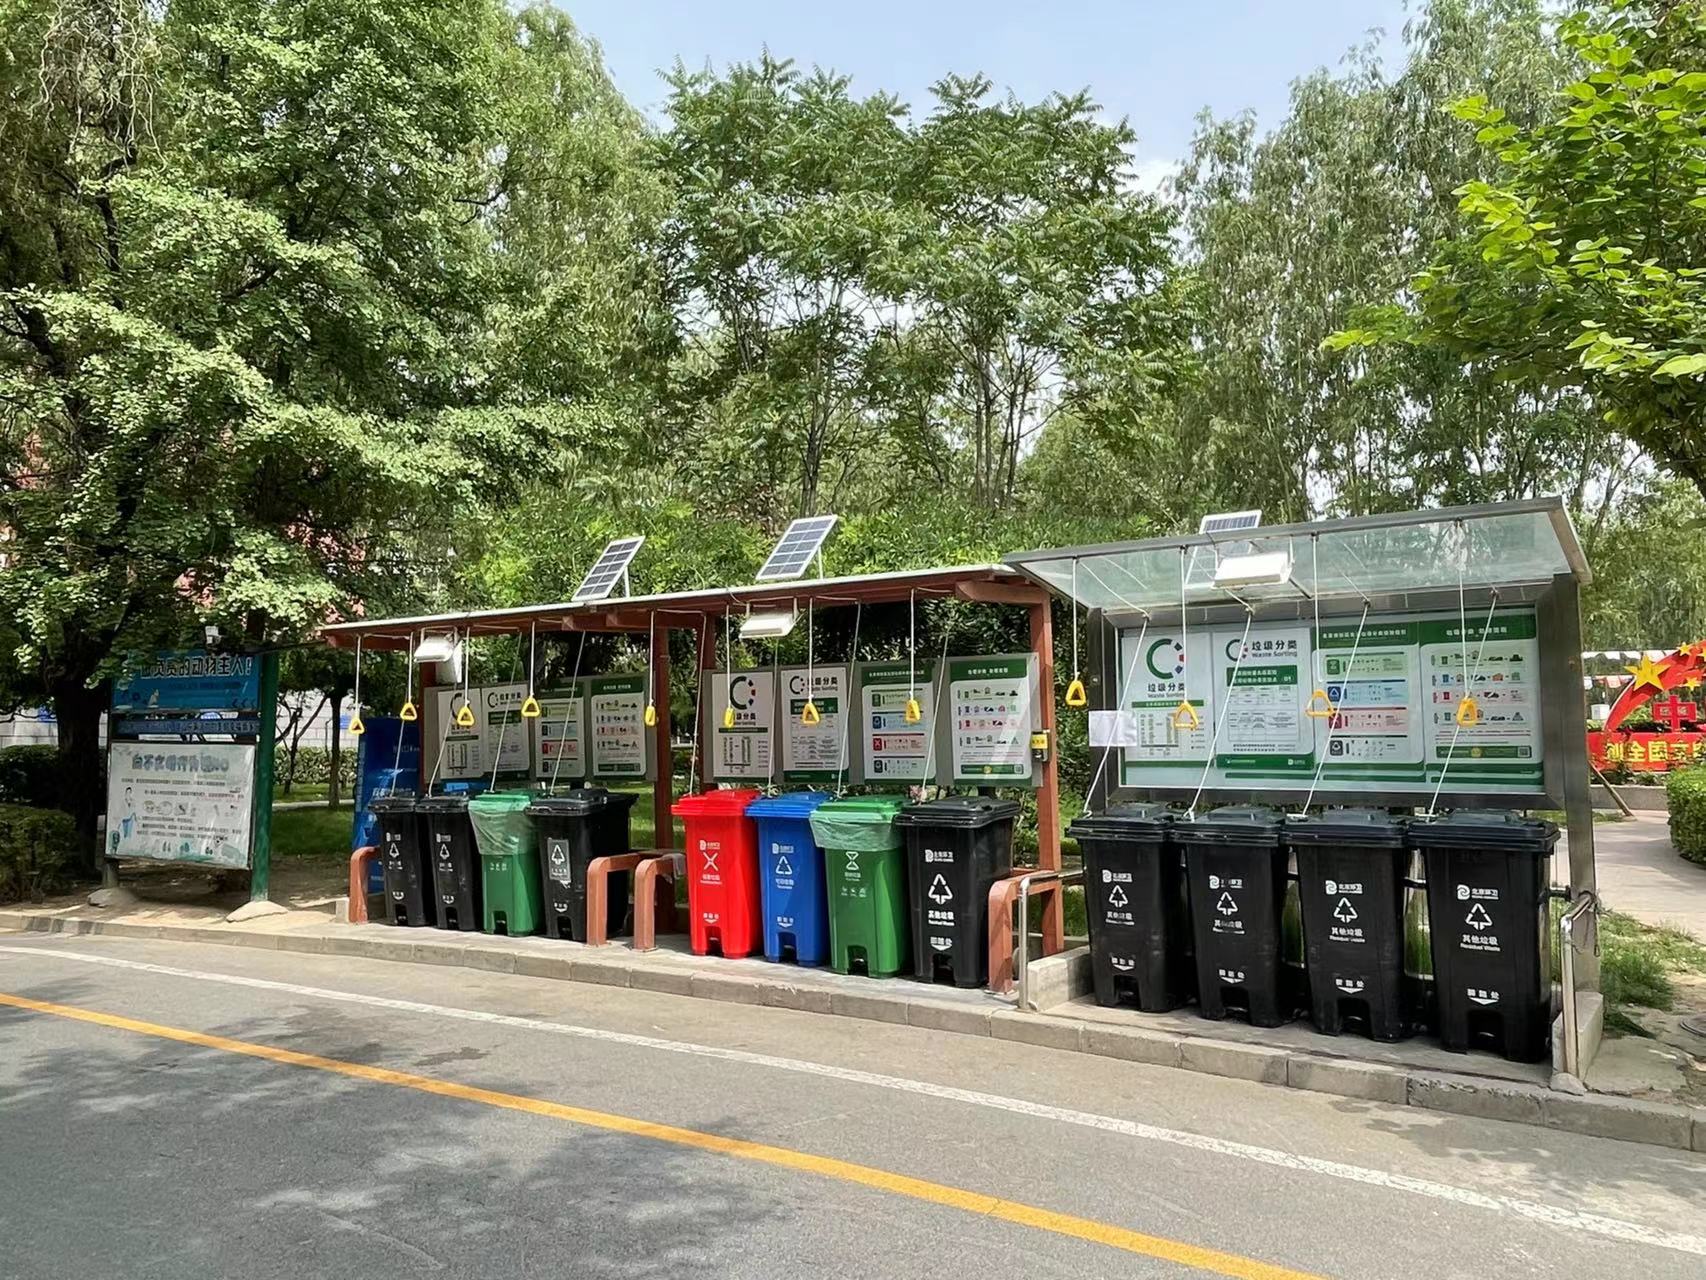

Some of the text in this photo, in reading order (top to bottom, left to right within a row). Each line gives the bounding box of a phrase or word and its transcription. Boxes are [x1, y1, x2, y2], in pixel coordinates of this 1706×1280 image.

[1252, 640, 1297, 650] 垃圾分类
[1148, 683, 1185, 692] 垃圾分类
[928, 910, 954, 920] 其他垃圾
[1331, 927, 1363, 937] 其他垃圾
[1462, 934, 1499, 945] 其他垃圾
